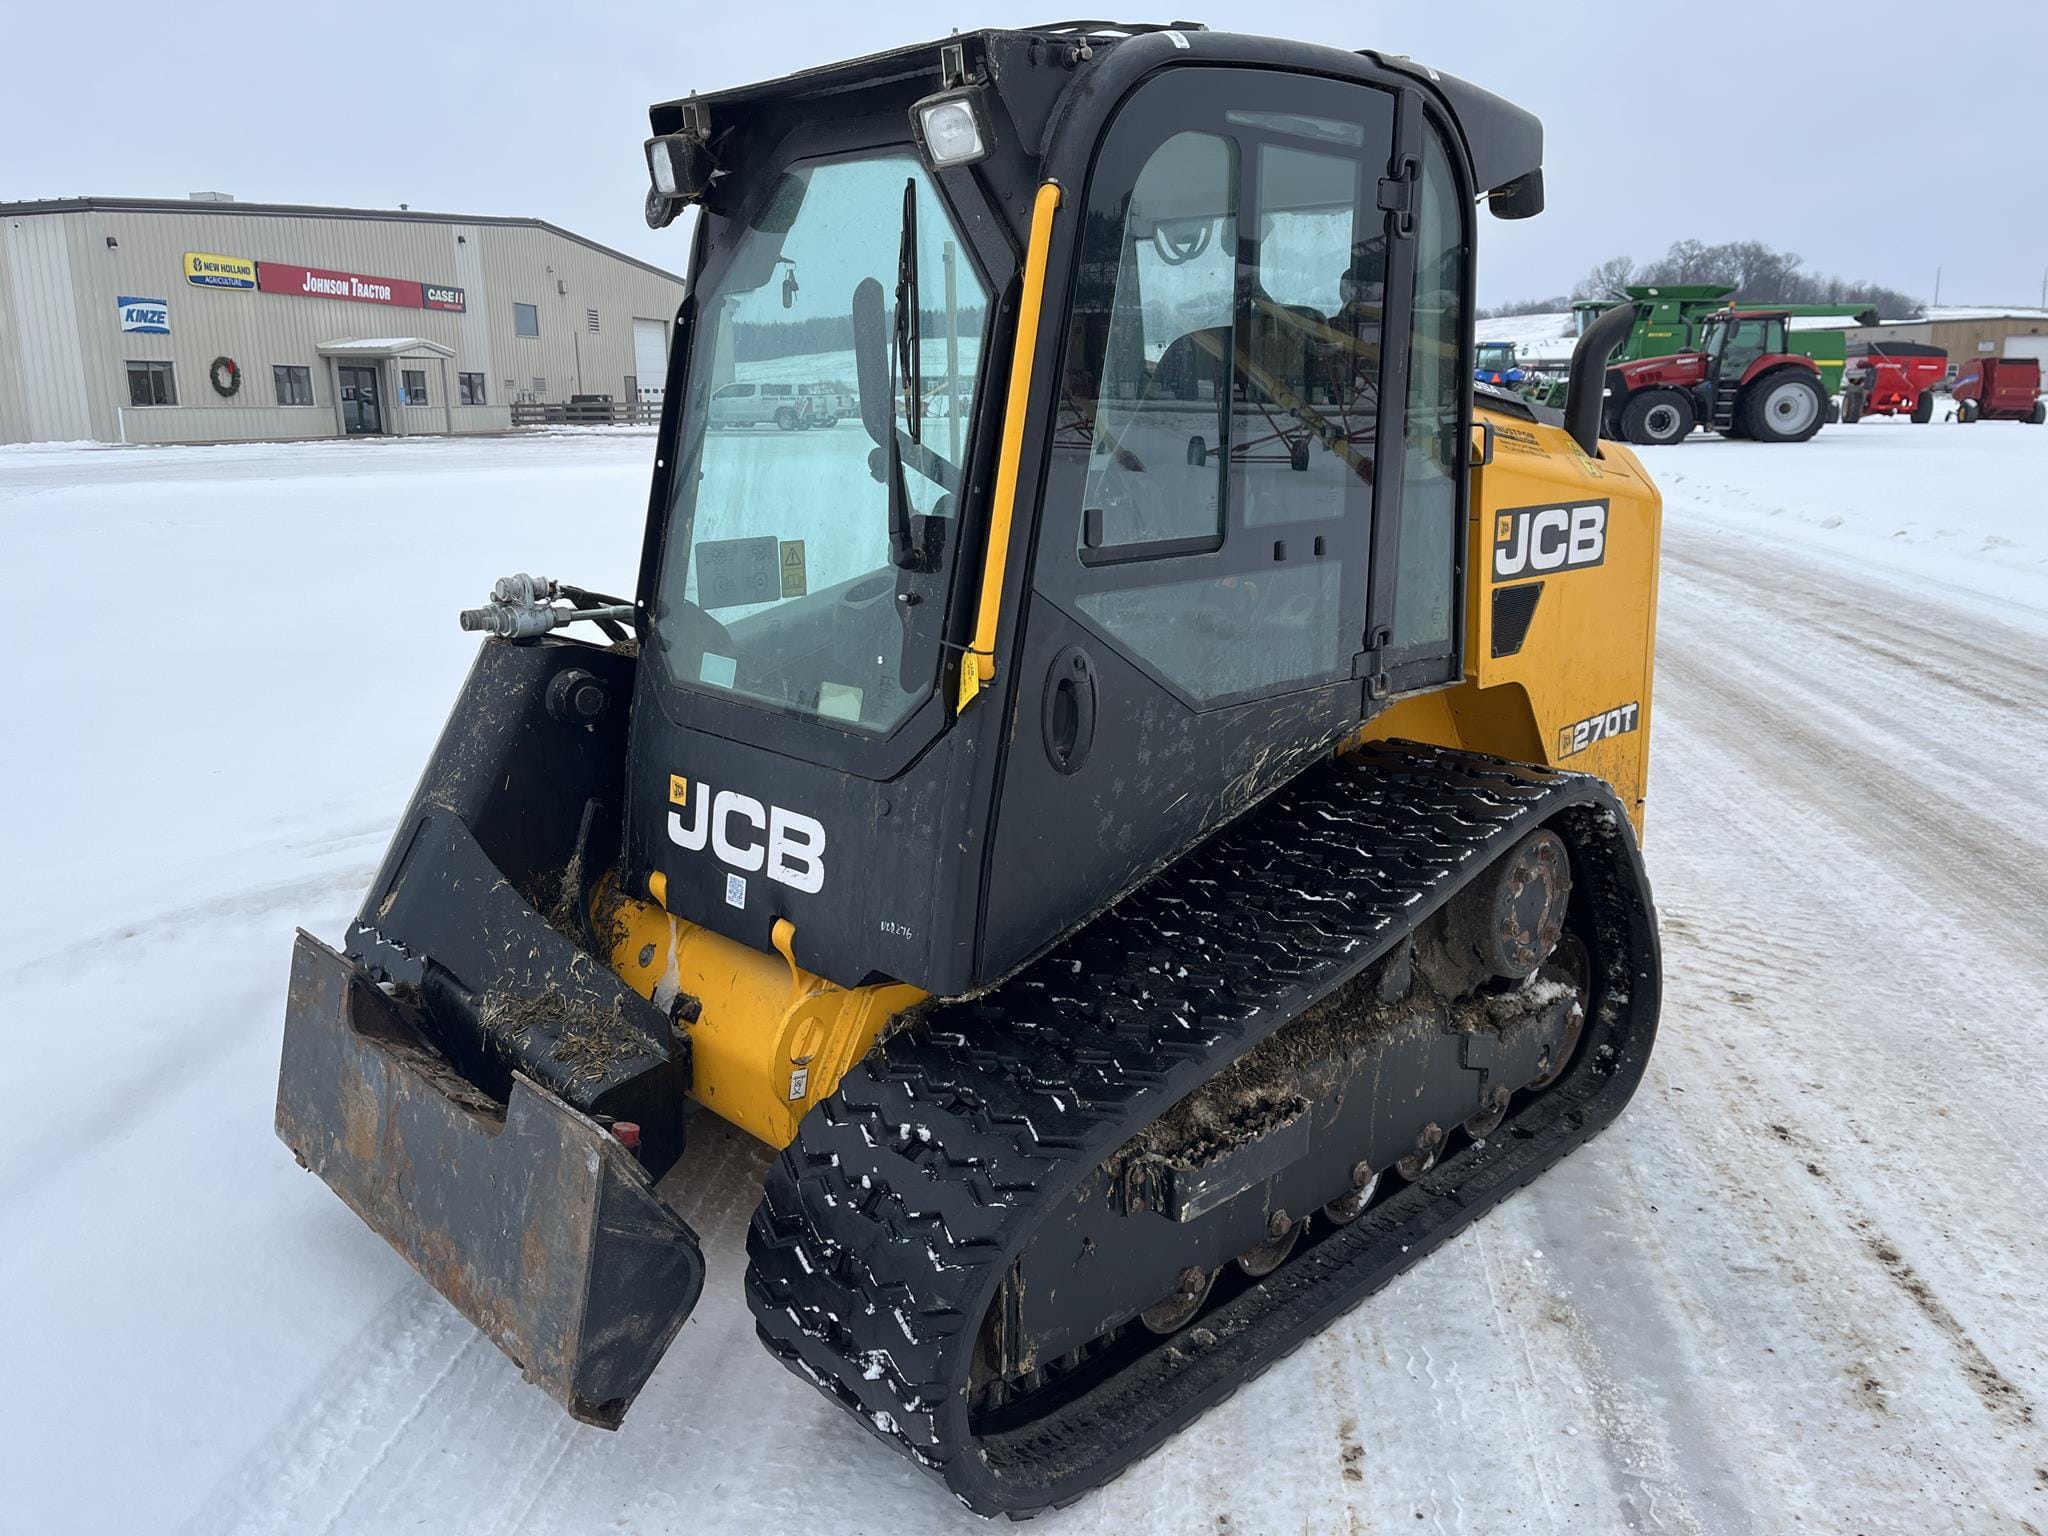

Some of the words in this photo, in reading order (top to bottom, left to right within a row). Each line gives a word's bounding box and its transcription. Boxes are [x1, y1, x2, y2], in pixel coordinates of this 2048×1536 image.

[203, 261, 220, 272] NEW
[220, 263, 251, 275] HOLLAND
[204, 276, 242, 287] AGRICULTURE
[302, 271, 349, 296] JOHNSON
[351, 277, 391, 300] TRACTOR
[125, 308, 167, 324] KINZE
[1496, 505, 1605, 576] JCB
[1573, 702, 1638, 752] 270T
[667, 781, 826, 894] JCB
